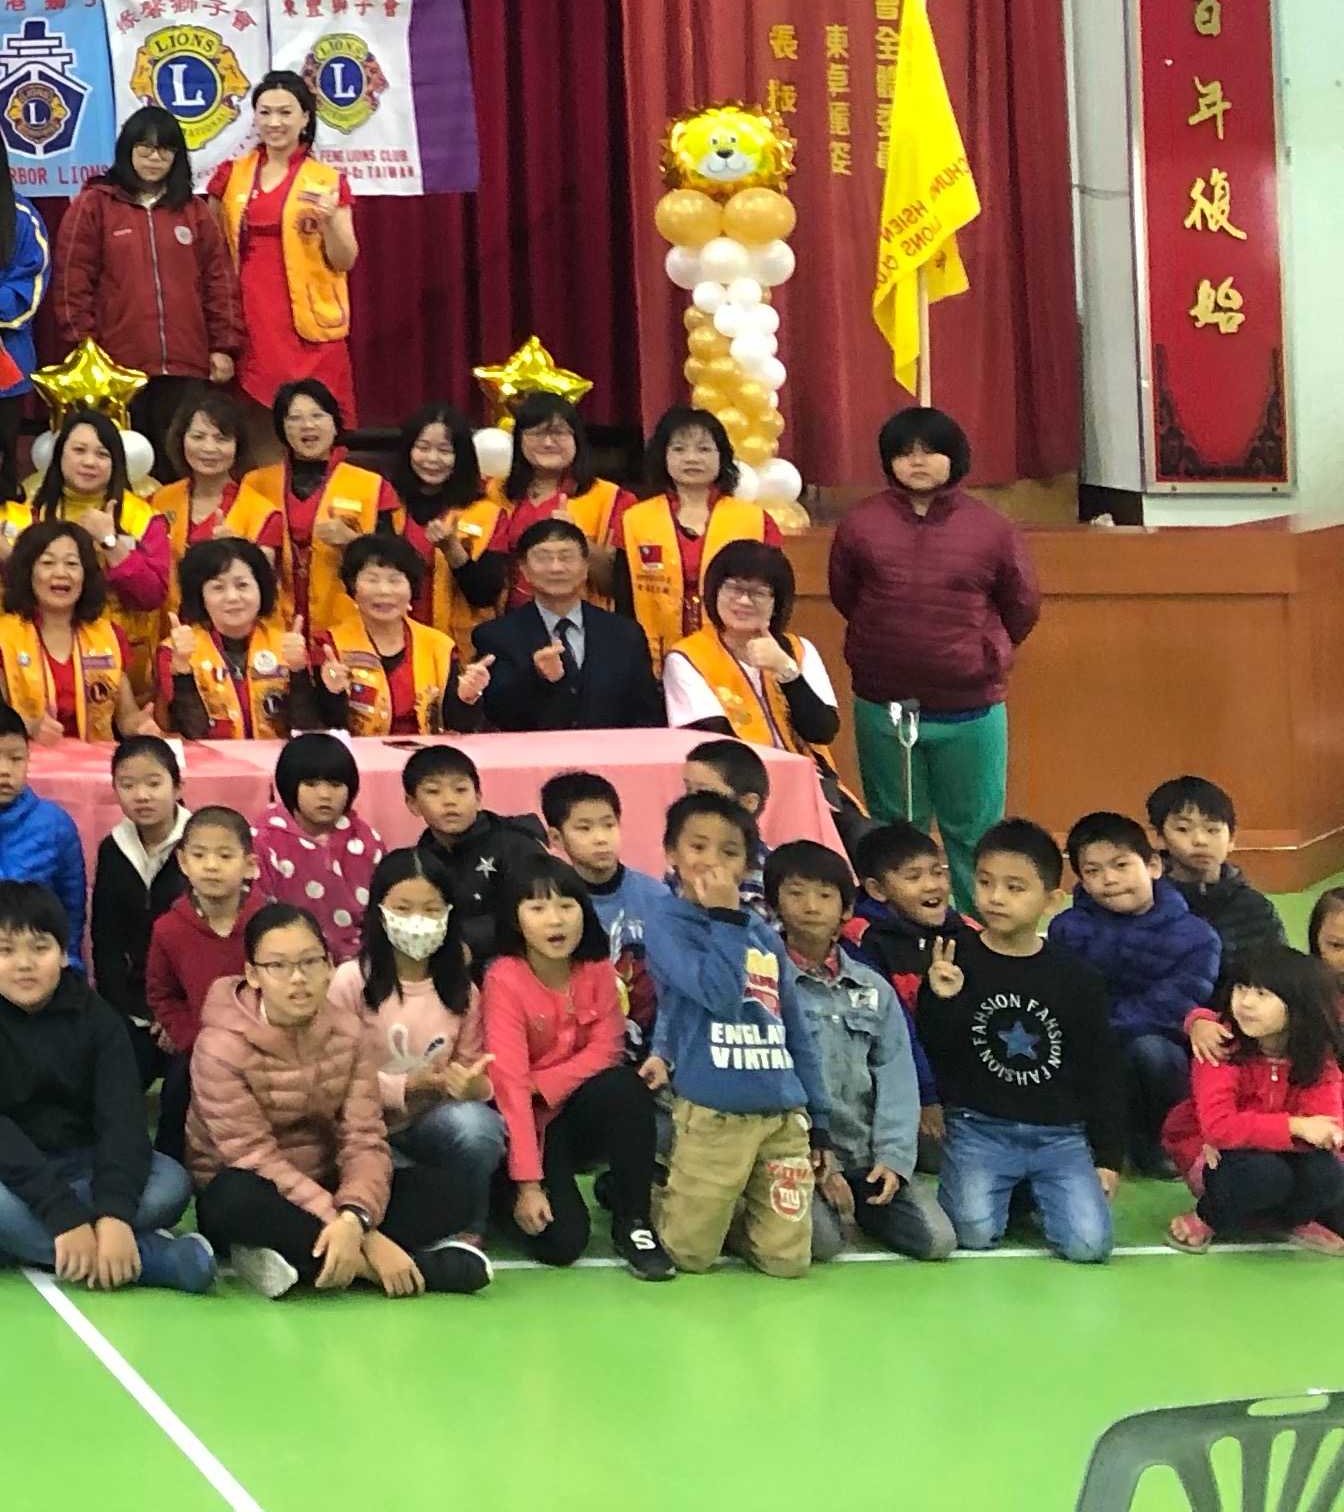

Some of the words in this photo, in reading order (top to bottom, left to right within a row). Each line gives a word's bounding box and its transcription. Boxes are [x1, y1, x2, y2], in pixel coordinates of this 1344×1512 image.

[155, 34, 214, 53] LIONS
[169, 63, 206, 106] L
[330, 63, 355, 99] L
[29, 107, 47, 126] L
[368, 166, 414, 178] TAIWAN
